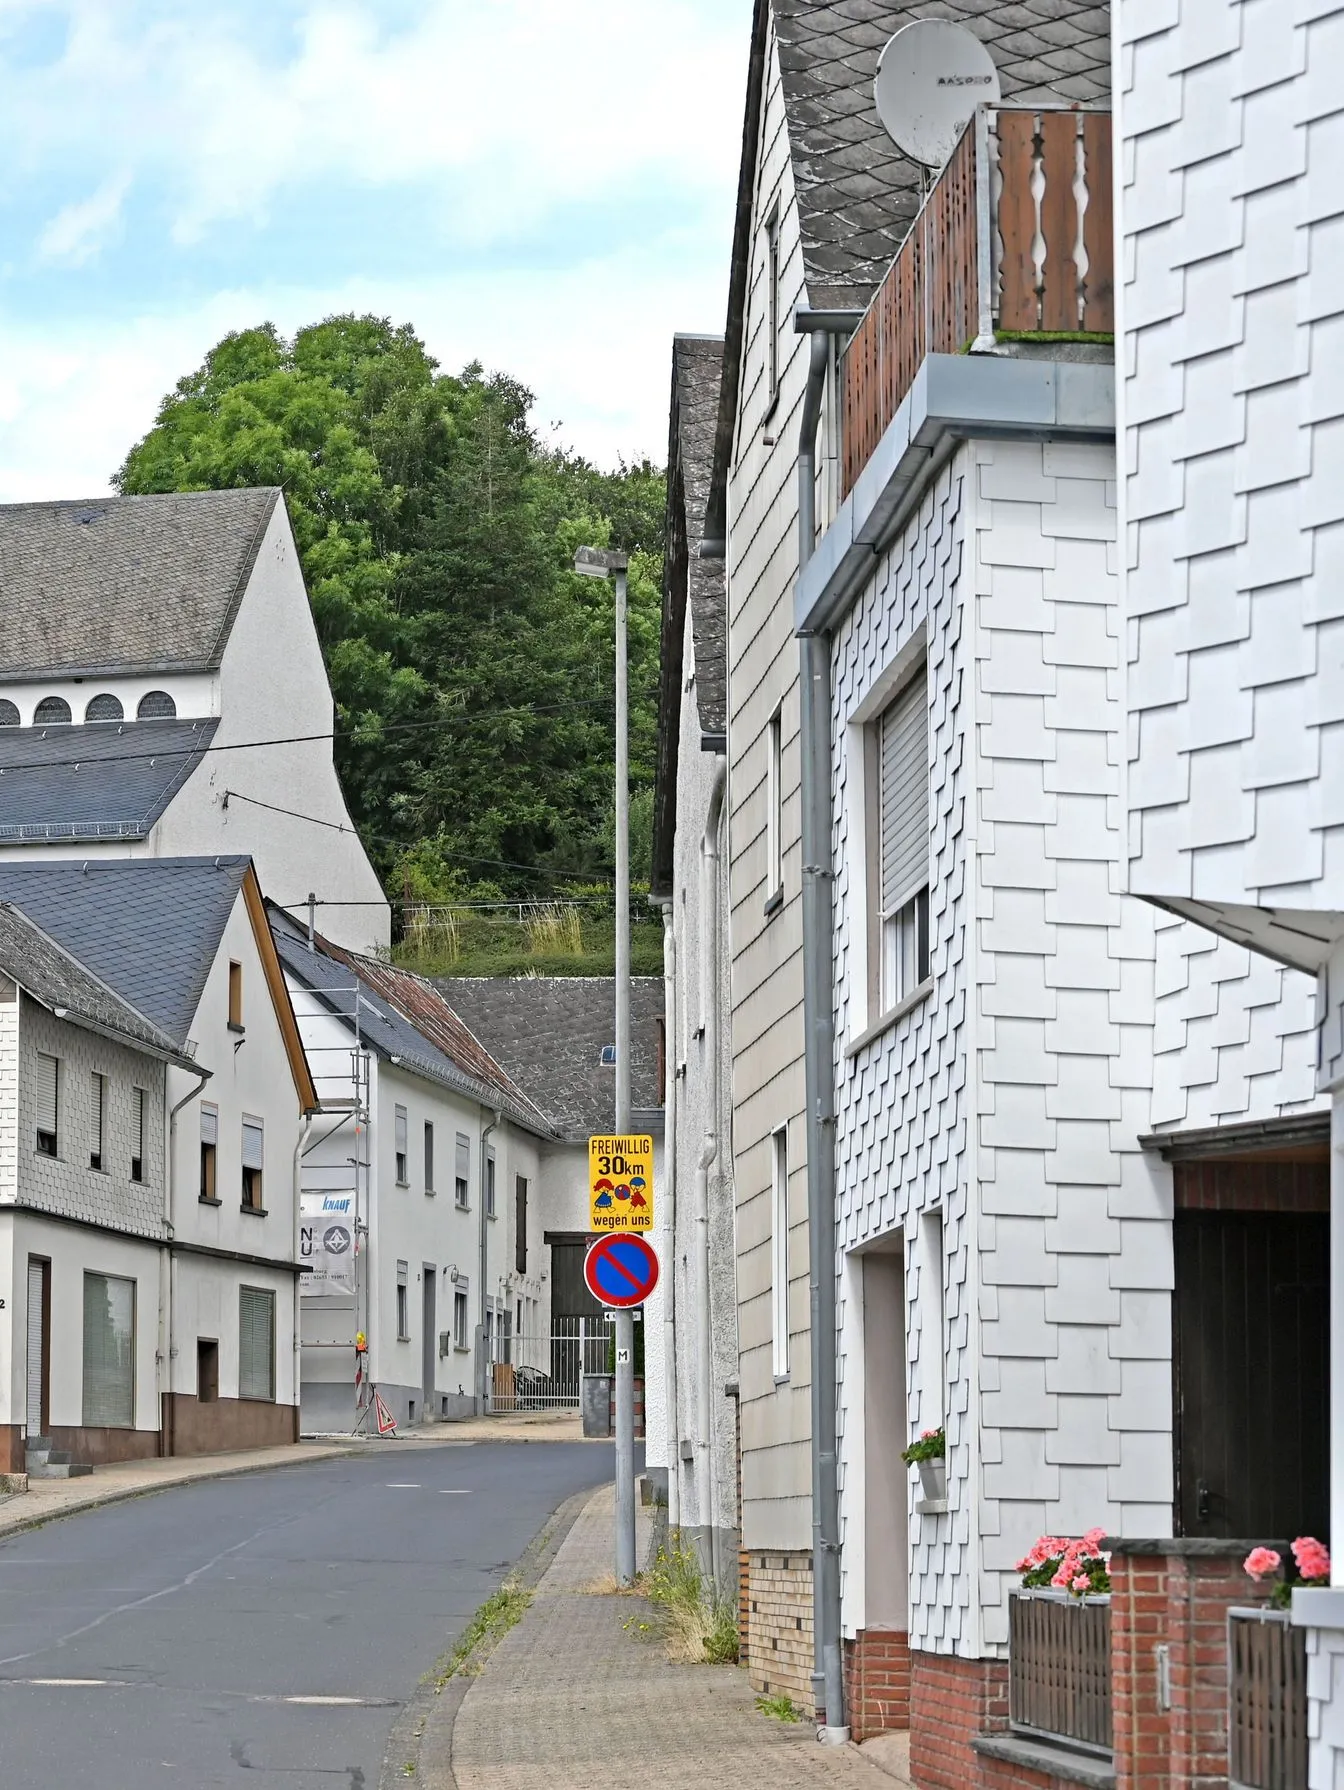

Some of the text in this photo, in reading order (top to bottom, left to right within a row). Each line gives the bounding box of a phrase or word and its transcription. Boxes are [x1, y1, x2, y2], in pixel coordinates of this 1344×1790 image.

[592, 1139, 650, 1155] FREIWILLIG
[323, 1196, 351, 1213] KNAUF
[593, 1216, 651, 1229] wegen uns
[0, 1299, 5, 1309] 2
[618, 1350, 628, 1361] M
